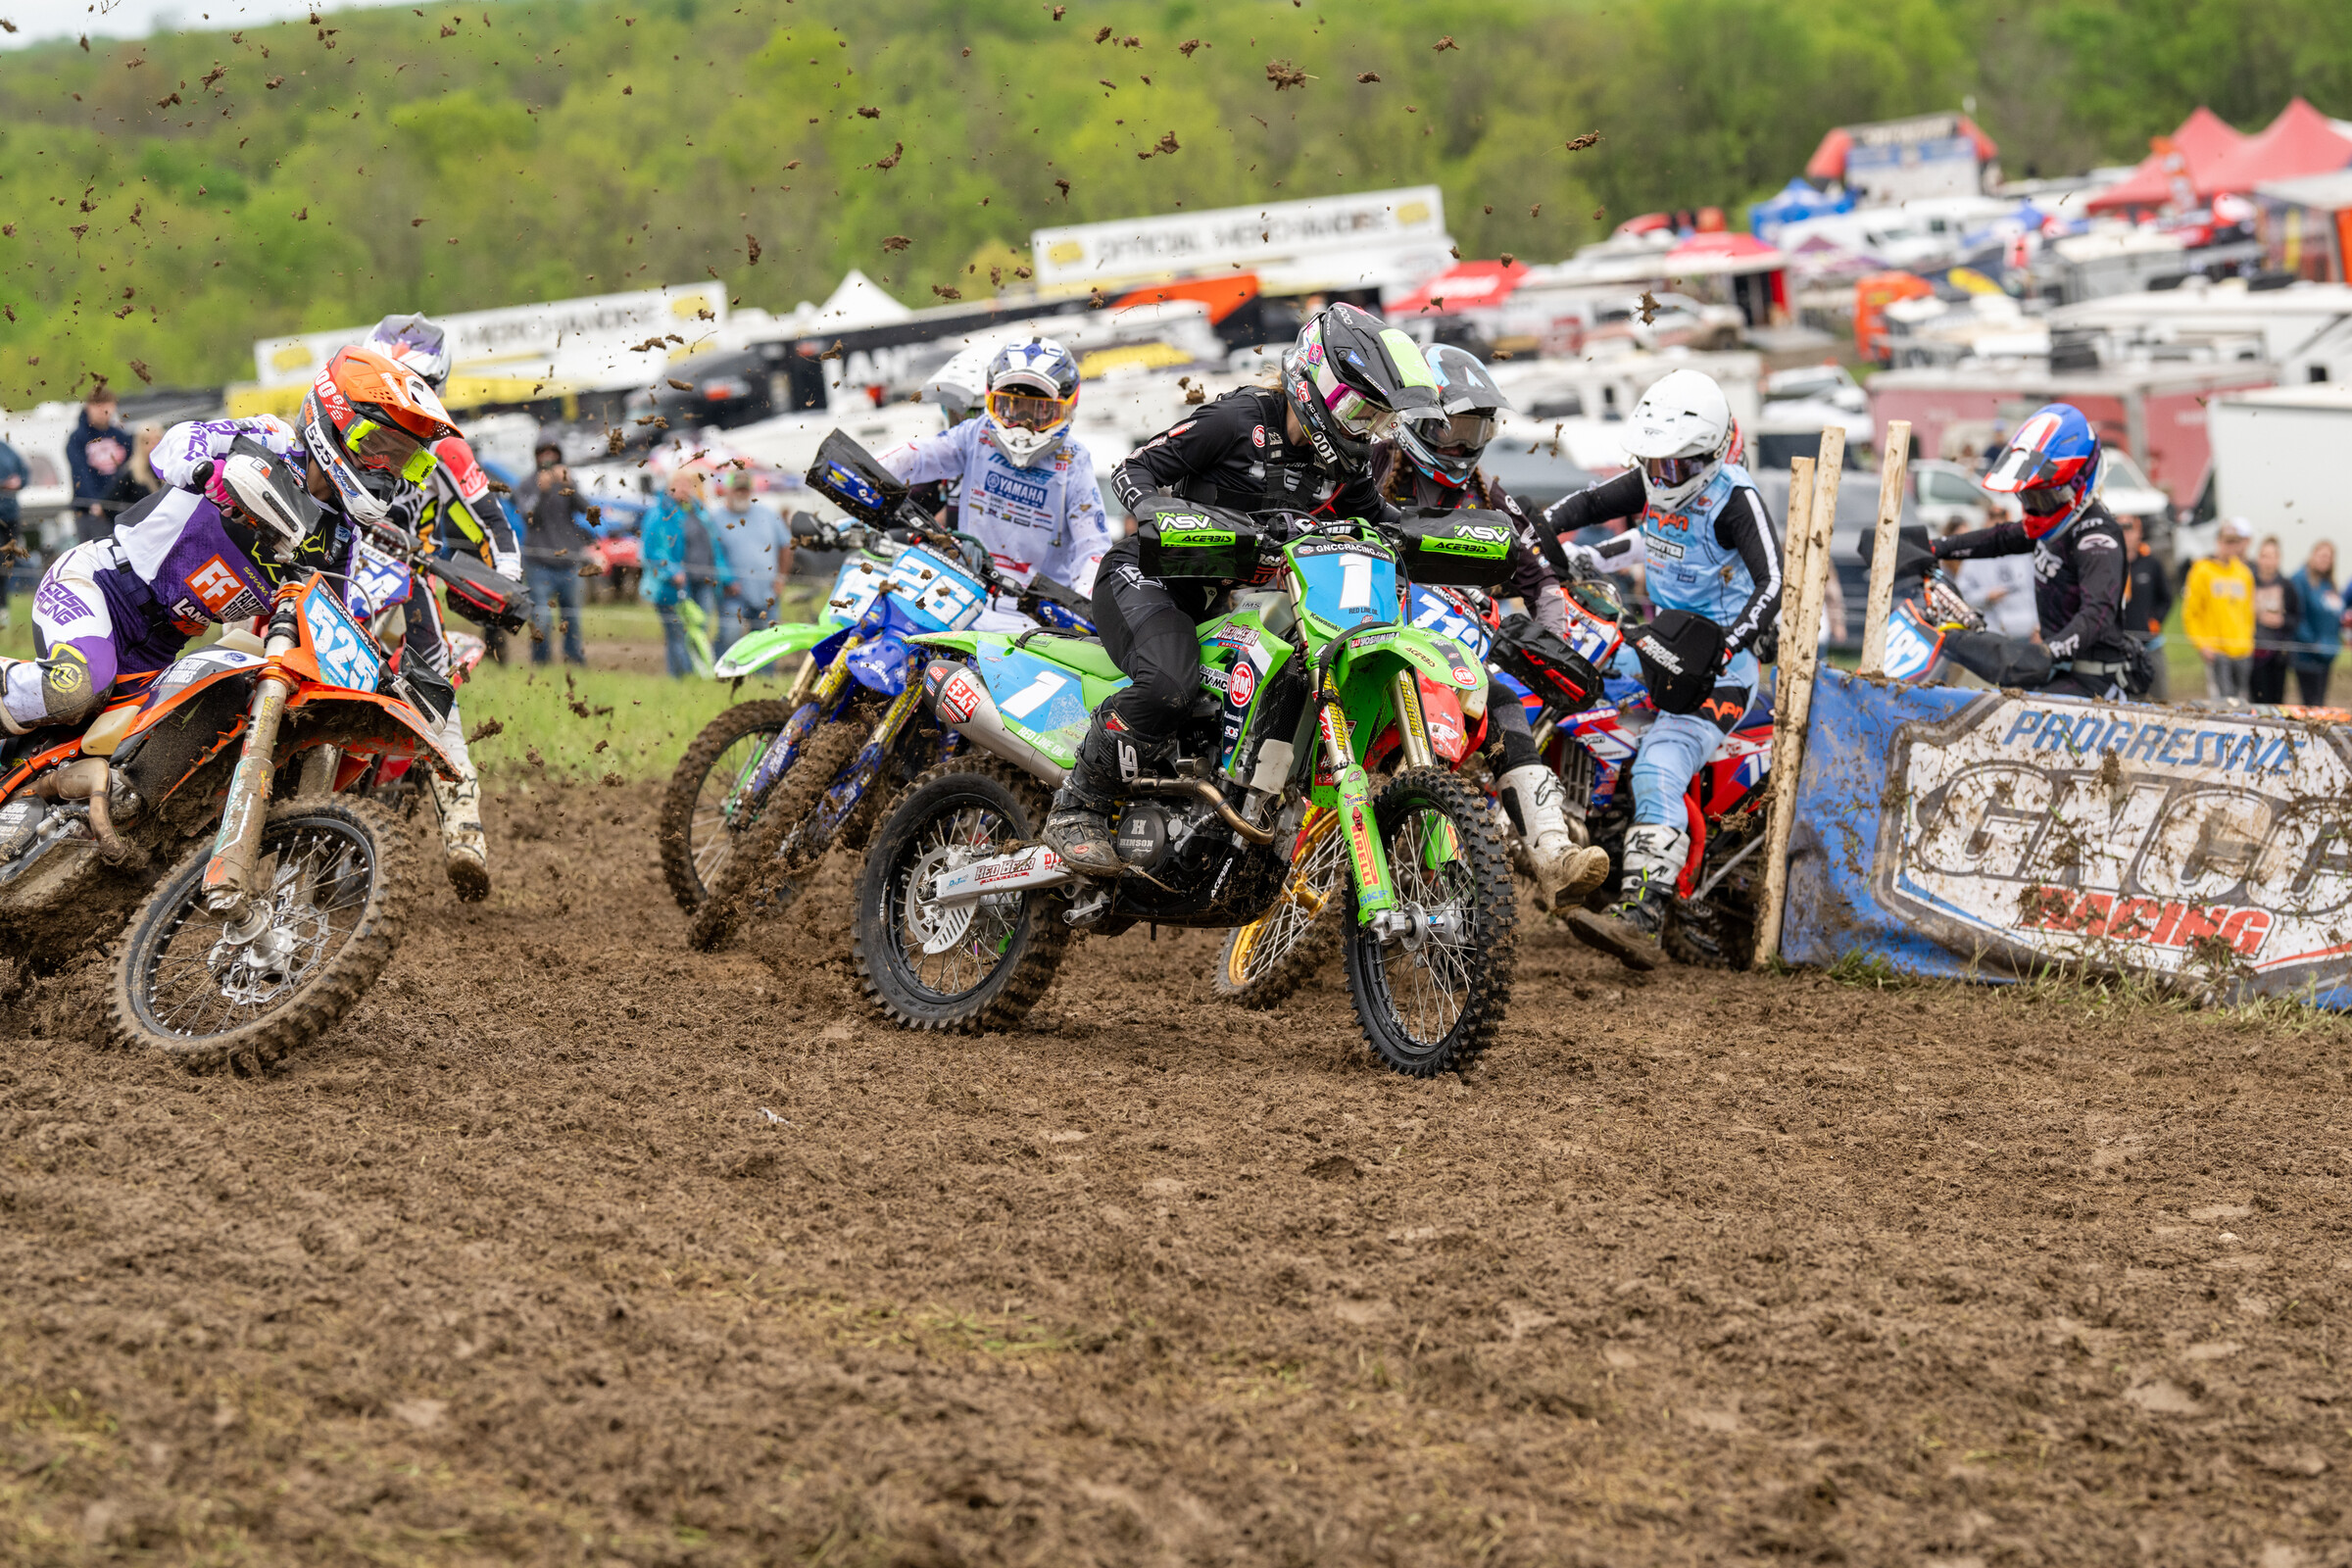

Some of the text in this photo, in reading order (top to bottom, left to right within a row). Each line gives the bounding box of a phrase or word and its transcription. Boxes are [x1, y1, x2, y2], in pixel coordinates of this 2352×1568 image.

[316, 368, 352, 421] 00%
[307, 425, 334, 466] 525
[1311, 431, 1336, 464] 001
[1000, 477, 1045, 504] YAMAHA
[1159, 515, 1210, 531] ASV
[1456, 525, 1510, 542] ASV
[1316, 543, 1391, 560] GNCCRACING.COM
[1434, 542, 1488, 553] ACERBIS
[190, 560, 242, 600] FF
[1339, 553, 1372, 610] 1
[172, 597, 211, 627] LAND
[1309, 612, 1342, 632] Kawasaki
[308, 598, 379, 693] 525
[1642, 635, 1680, 663] MOOSE
[1000, 670, 1068, 720] 1
[1017, 726, 1067, 759] RED LINE OIL
[1225, 725, 1239, 737] SOS
[2003, 710, 2306, 776] PROGRESSIVE
[1344, 795, 1371, 808] SUNOCO
[1119, 838, 1154, 848] HINSON
[1918, 760, 2352, 912] GNCC
[974, 858, 1037, 881] RED BEAR
[1360, 890, 1389, 906] SKF
[2021, 886, 2273, 955] RACING
